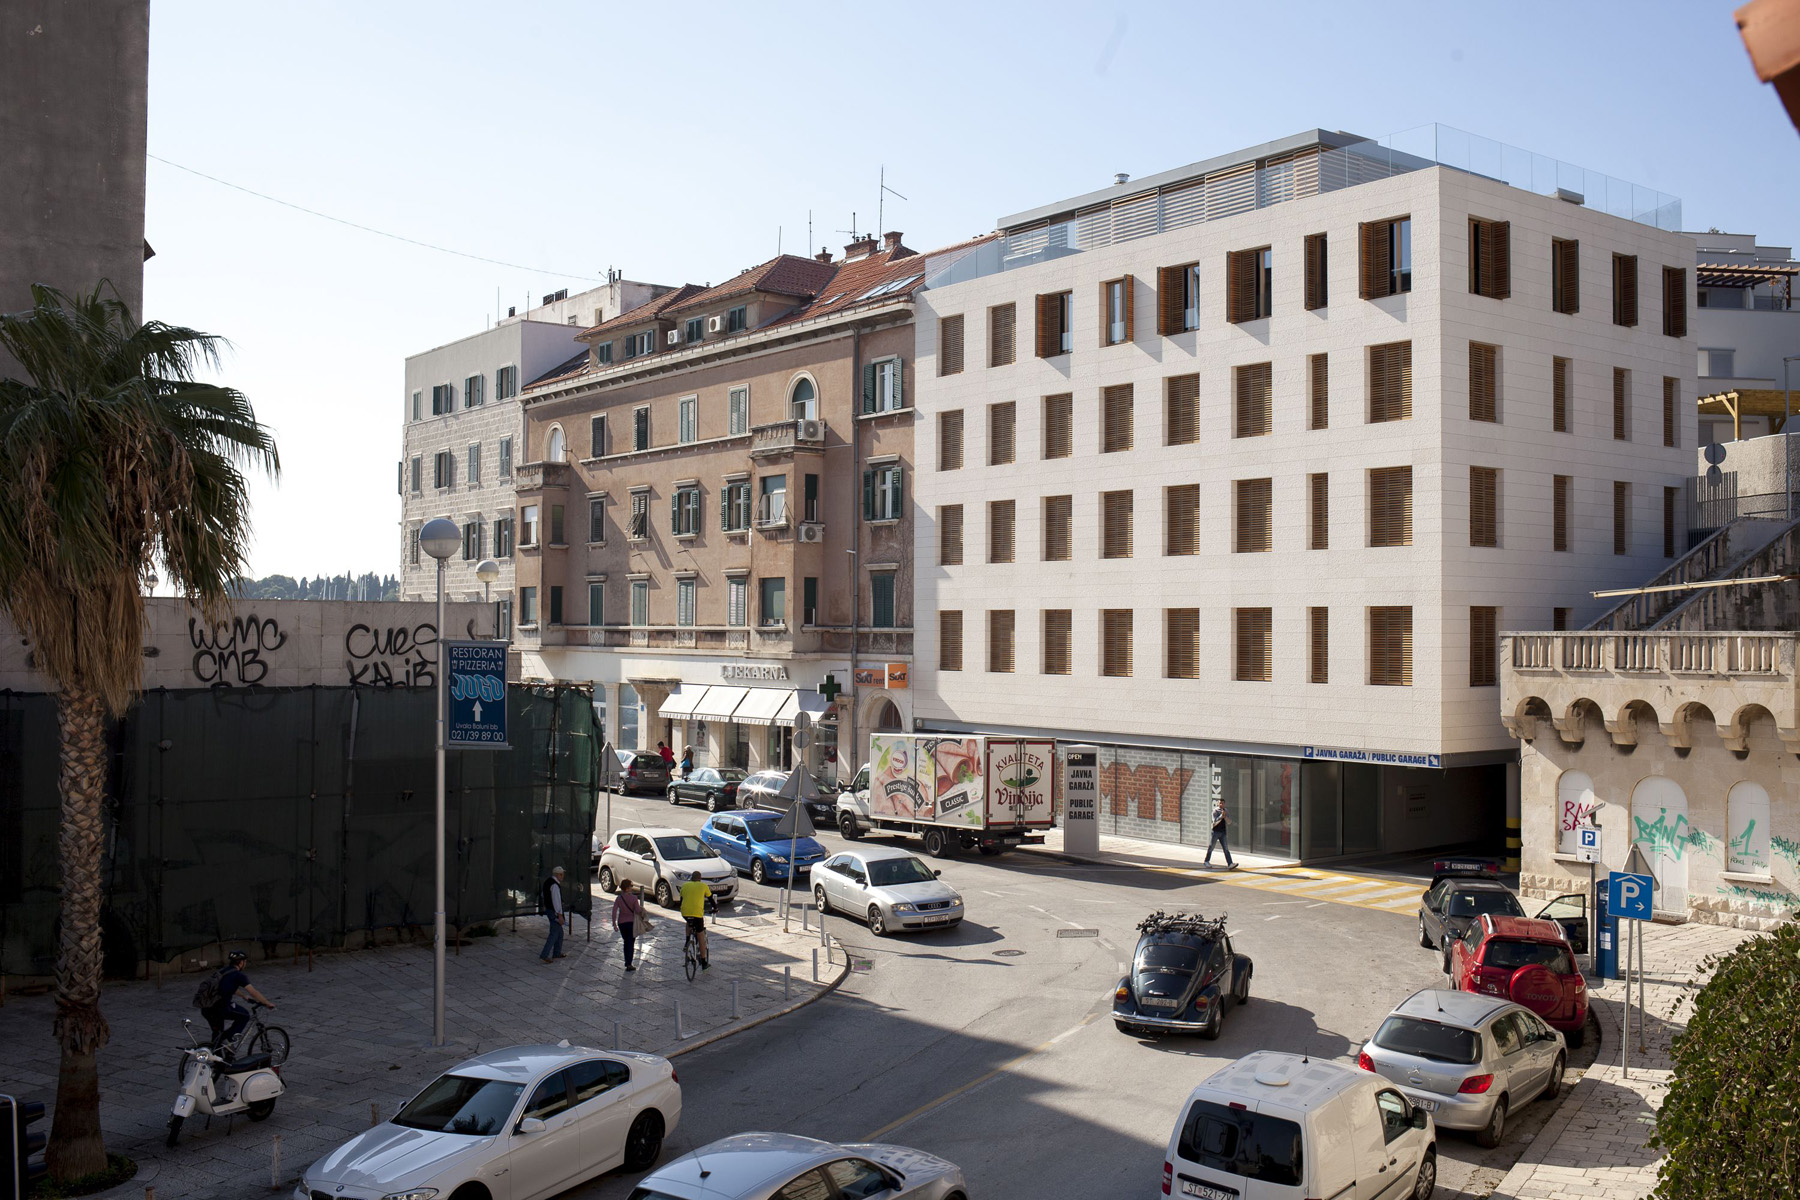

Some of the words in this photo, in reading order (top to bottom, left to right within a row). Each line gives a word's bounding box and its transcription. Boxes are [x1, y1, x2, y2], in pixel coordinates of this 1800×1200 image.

[452, 647, 502, 659] RESTORAN
[459, 660, 497, 671] PIZZERIA
[720, 664, 790, 680] LJEKARNA
[451, 672, 504, 702] JUGO
[451, 730, 479, 740] 021/39
[481, 731, 492, 741] 89
[493, 732, 504, 741] 00
[1315, 748, 1338, 759] JAVNA
[1338, 749, 1367, 761] GARAŽA
[1371, 753, 1397, 763] PUBLIC
[1397, 755, 1427, 765] GARAGE
[1071, 769, 1093, 779] JAVNA
[1068, 781, 1095, 791] GARAŽA
[944, 795, 965, 808] CLASSIC
[1069, 799, 1094, 808] PUBLIC
[1068, 811, 1094, 820] GARAGE
[1584, 832, 1594, 845] P
[1620, 881, 1640, 908] P
[1527, 993, 1559, 1002] TOYOTA
[1187, 1183, 1198, 1194] ST
